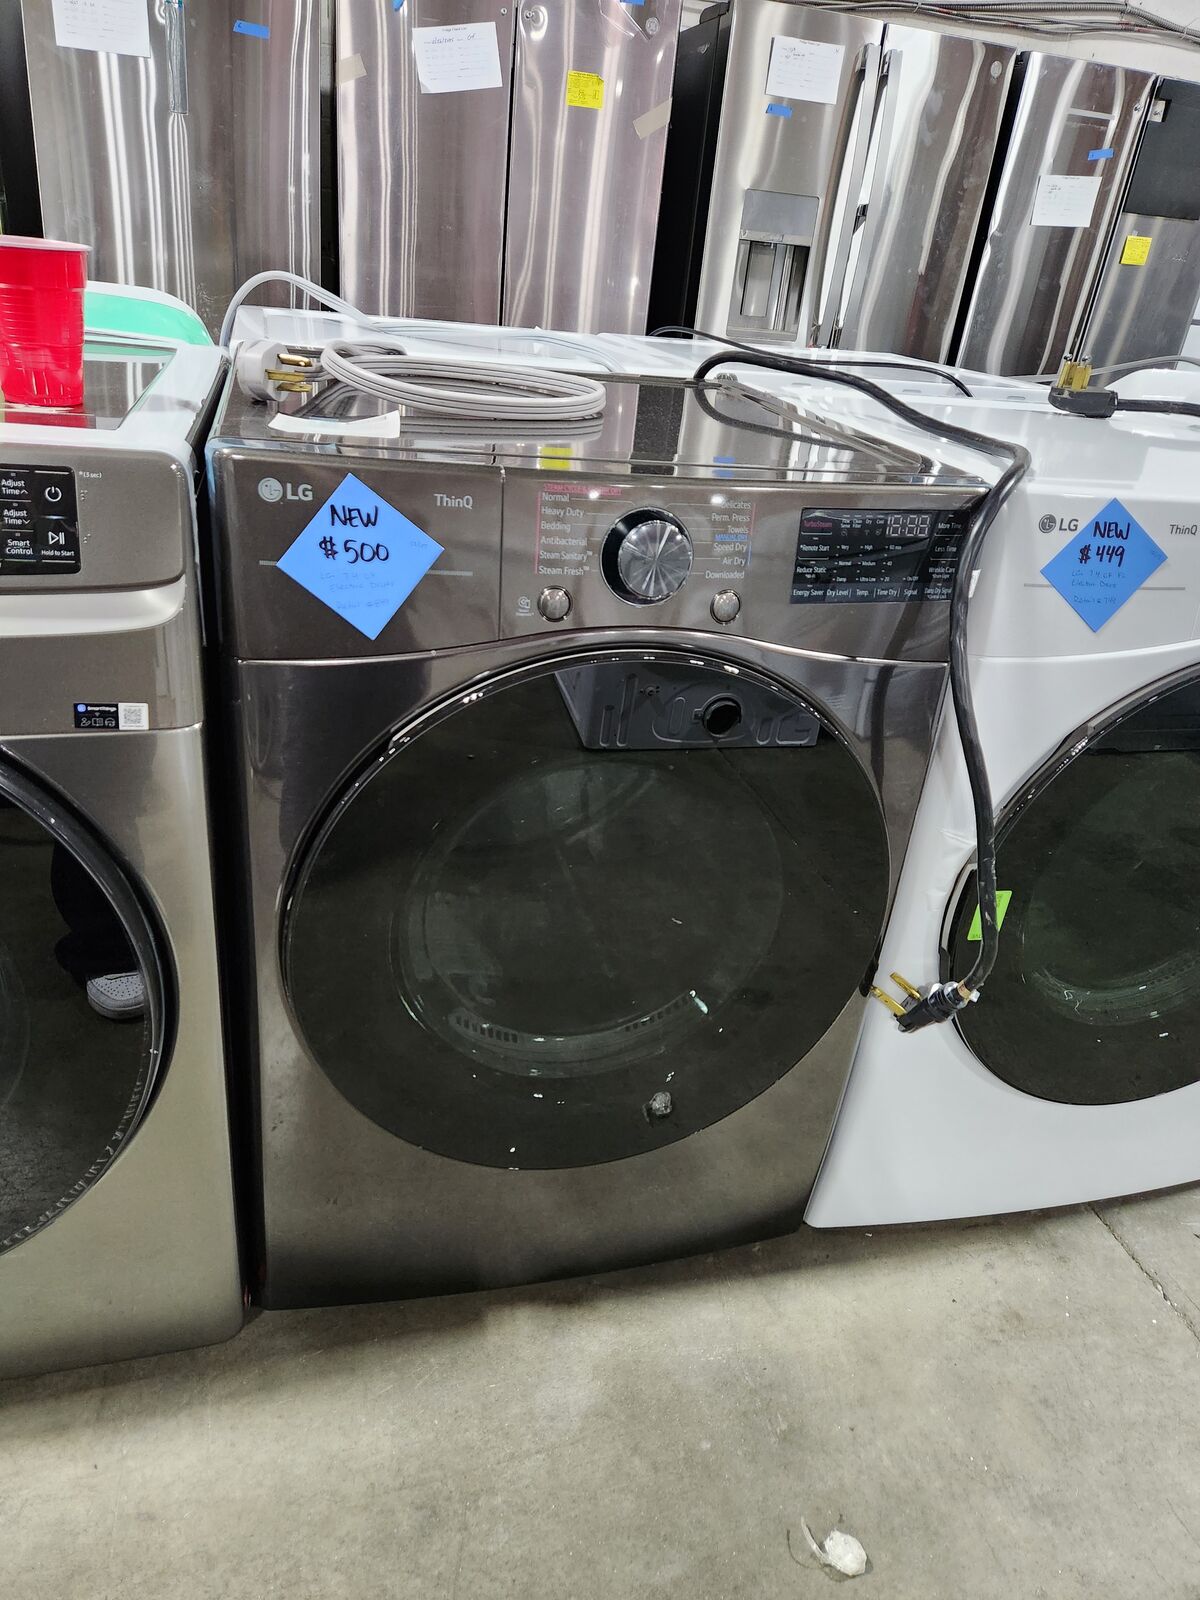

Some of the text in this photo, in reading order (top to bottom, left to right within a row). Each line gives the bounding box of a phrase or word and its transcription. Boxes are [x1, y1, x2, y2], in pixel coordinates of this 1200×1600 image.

[1, 479, 25, 488] Adjust
[2, 487, 20, 495] Time
[286, 482, 313, 501] LG
[433, 493, 473, 510] ThinQ
[542, 492, 570, 502] Normal
[3, 509, 27, 518] Adjust
[330, 504, 379, 527] NEW
[542, 507, 584, 517] Heavy Duty
[711, 512, 750, 522] Perm. Press
[541, 520, 571, 532] Bedding
[727, 525, 749, 534] Towels
[1058, 518, 1079, 532] LG
[1093, 521, 1131, 540] NEW
[1169, 524, 1198, 536] ThinQ
[7, 539, 31, 548] Smart
[540, 537, 588, 546] Antibacterial
[713, 542, 747, 553] Speed Dry
[540, 551, 560, 560] Steam
[722, 557, 745, 566] Air Dry
[539, 565, 562, 575] Steam
[705, 570, 745, 579] Downloaded
[792, 589, 810, 598] Energy
[826, 589, 836, 597] Dry
[888, 589, 898, 597] Dry
[903, 588, 918, 597] Signal
